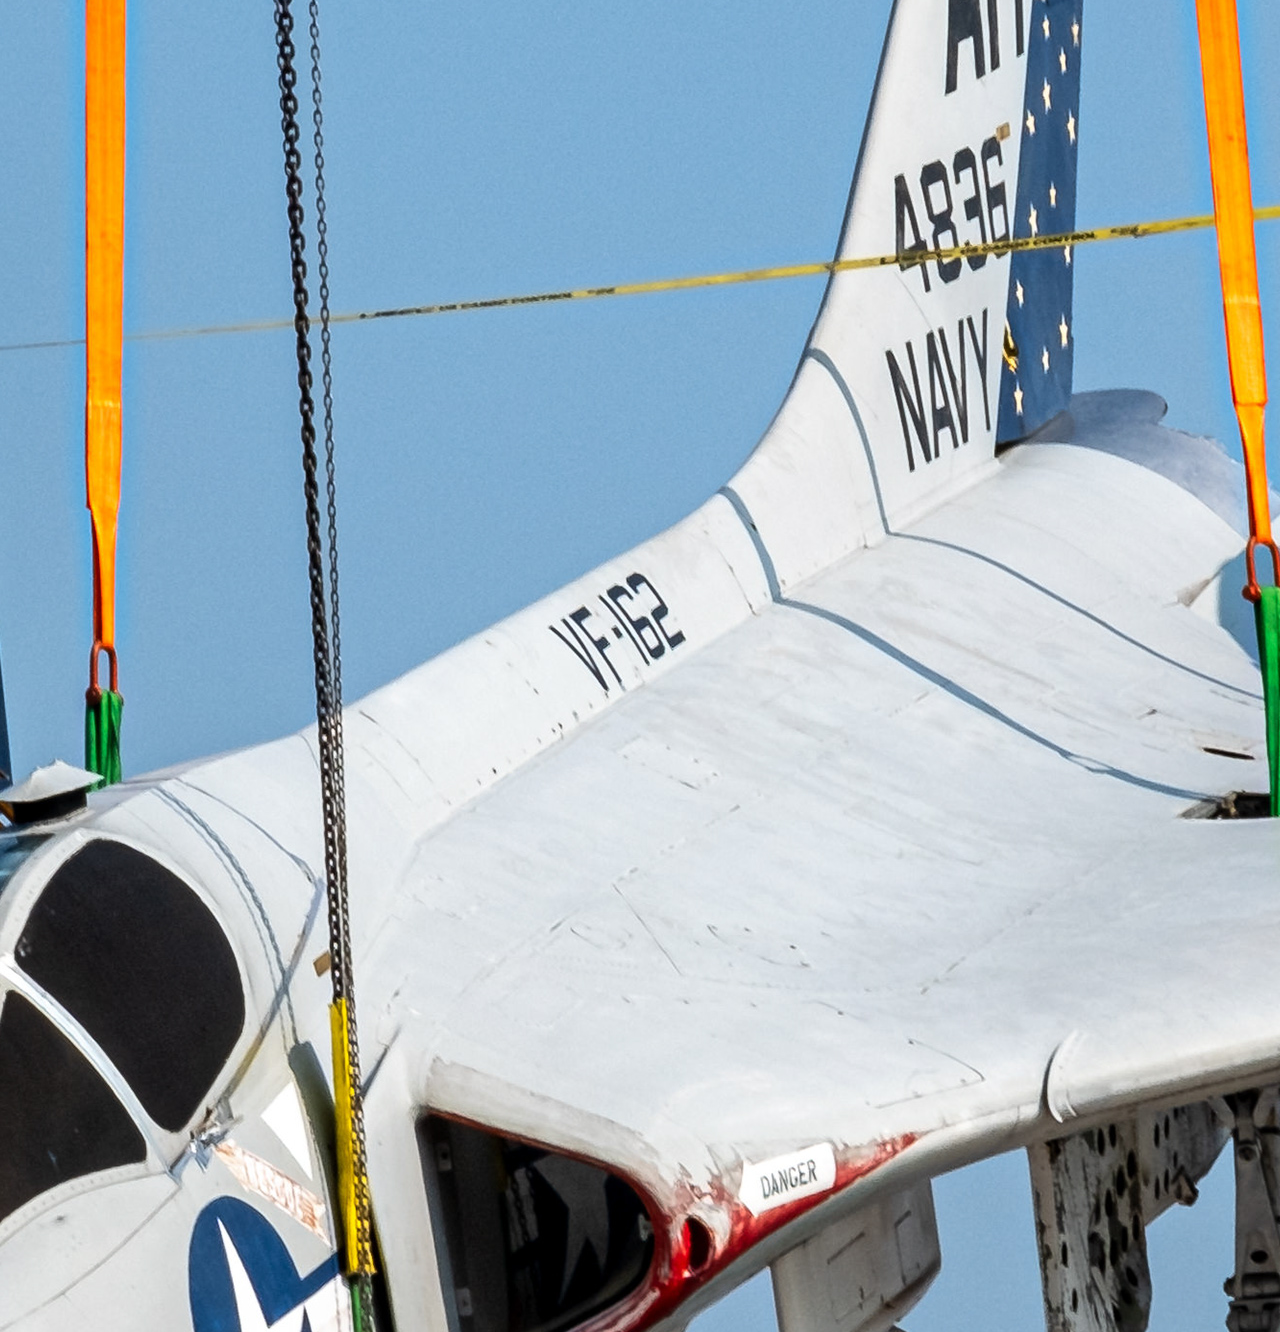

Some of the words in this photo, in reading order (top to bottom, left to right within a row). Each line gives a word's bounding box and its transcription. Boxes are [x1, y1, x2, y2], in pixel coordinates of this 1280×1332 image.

[893, 135, 1012, 293] 4836
[885, 307, 992, 473] NAVY
[548, 572, 687, 692] VF-162
[760, 1159, 819, 1200] DANGER
